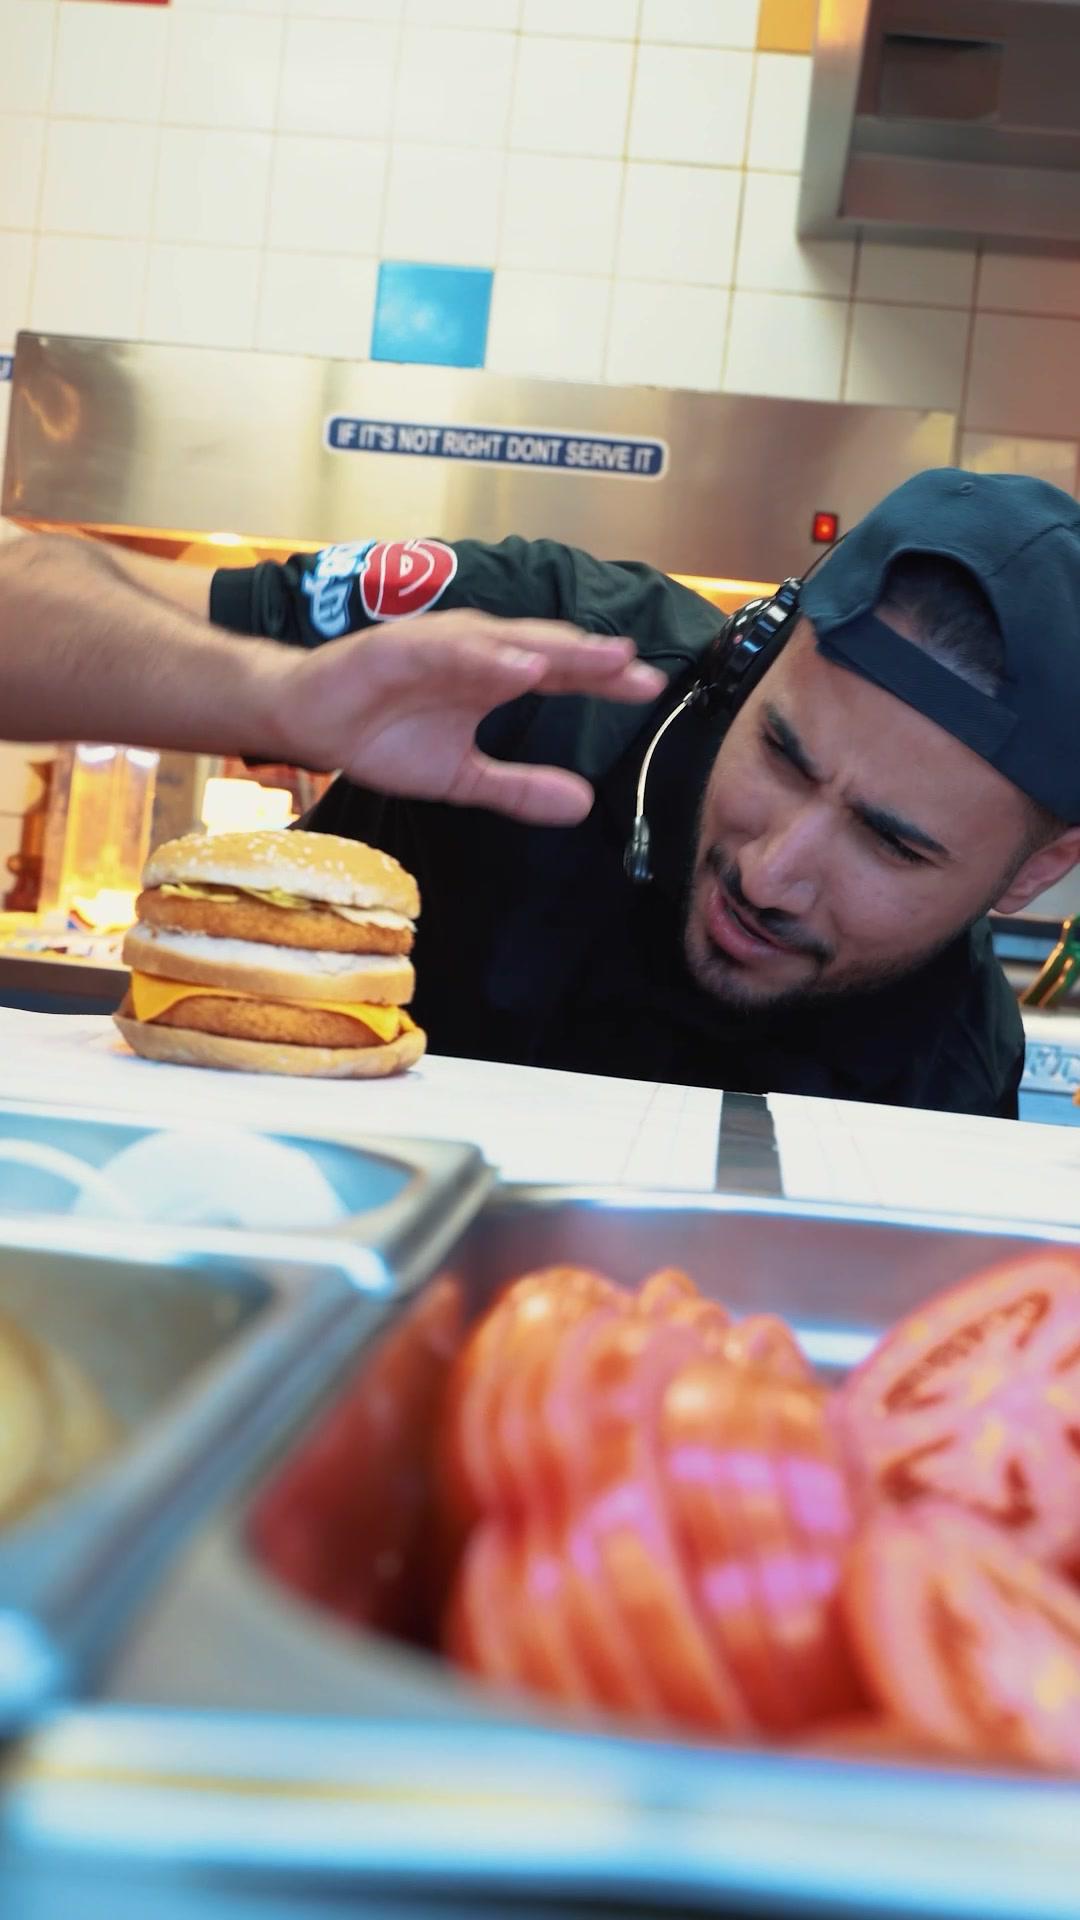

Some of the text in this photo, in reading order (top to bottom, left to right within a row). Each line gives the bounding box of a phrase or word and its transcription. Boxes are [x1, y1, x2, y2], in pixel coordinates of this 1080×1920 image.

[336, 422, 357, 446] IF
[397, 427, 440, 453] NOT
[442, 431, 504, 459] RIGHT
[506, 436, 563, 464] DONT
[565, 440, 631, 470] SERVE
[633, 446, 655, 472] IT
